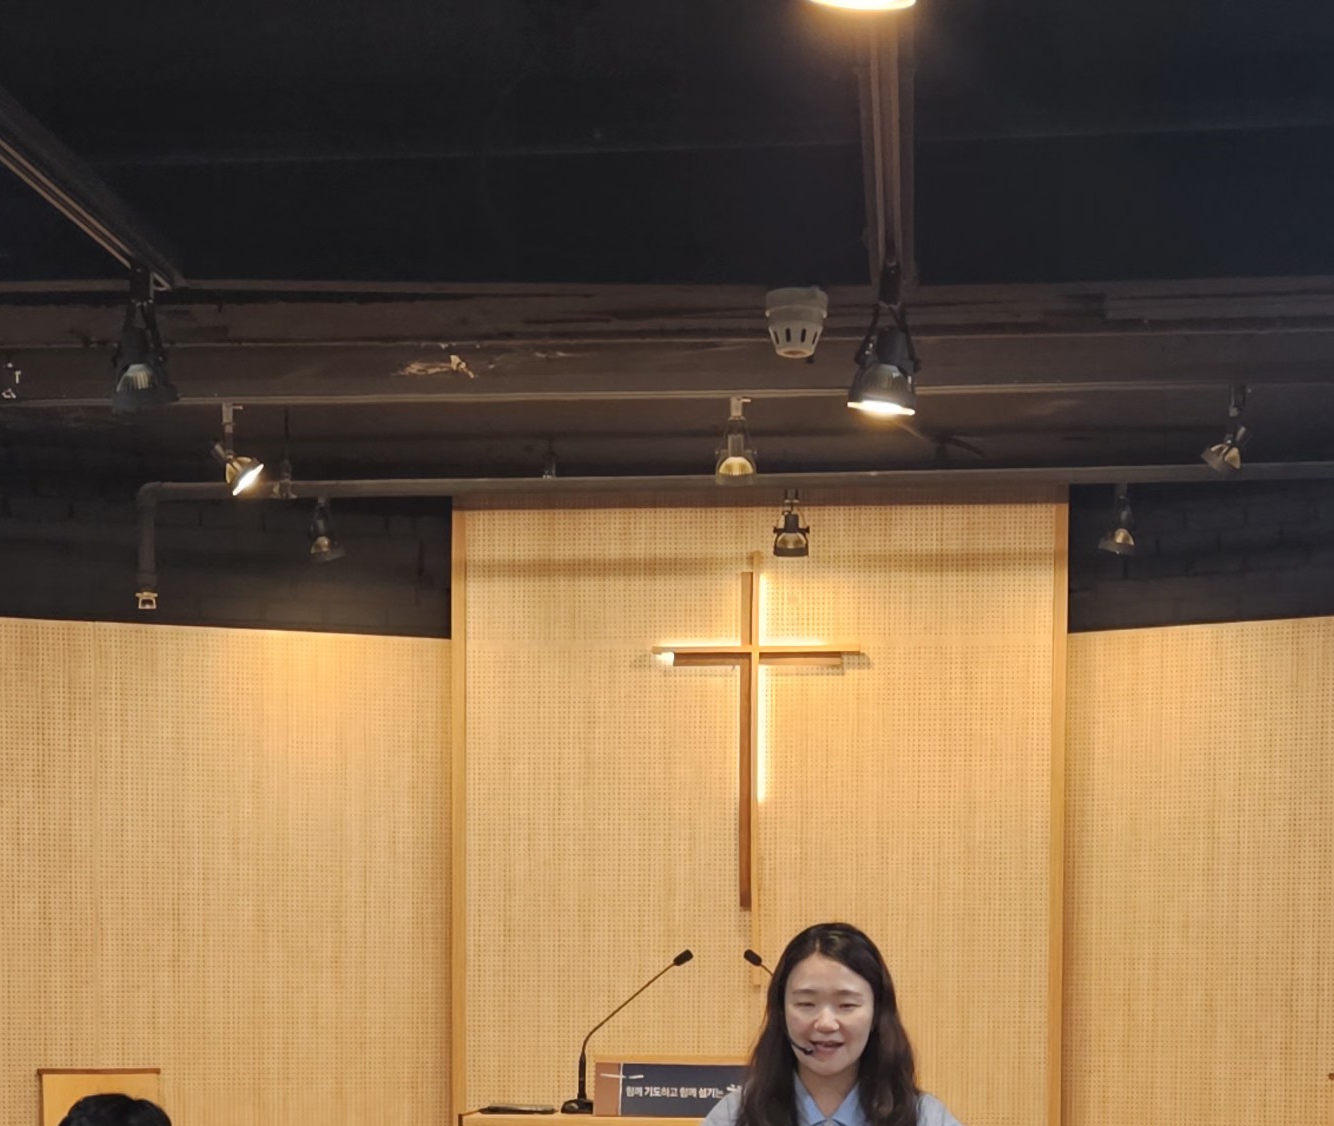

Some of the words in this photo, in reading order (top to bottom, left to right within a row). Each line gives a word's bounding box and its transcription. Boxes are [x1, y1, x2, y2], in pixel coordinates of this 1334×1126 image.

[625, 1085, 643, 1098] 함께
[644, 1085, 678, 1098] 기도하고
[679, 1085, 698, 1099] 함께
[698, 1086, 725, 1099] 섬기는
